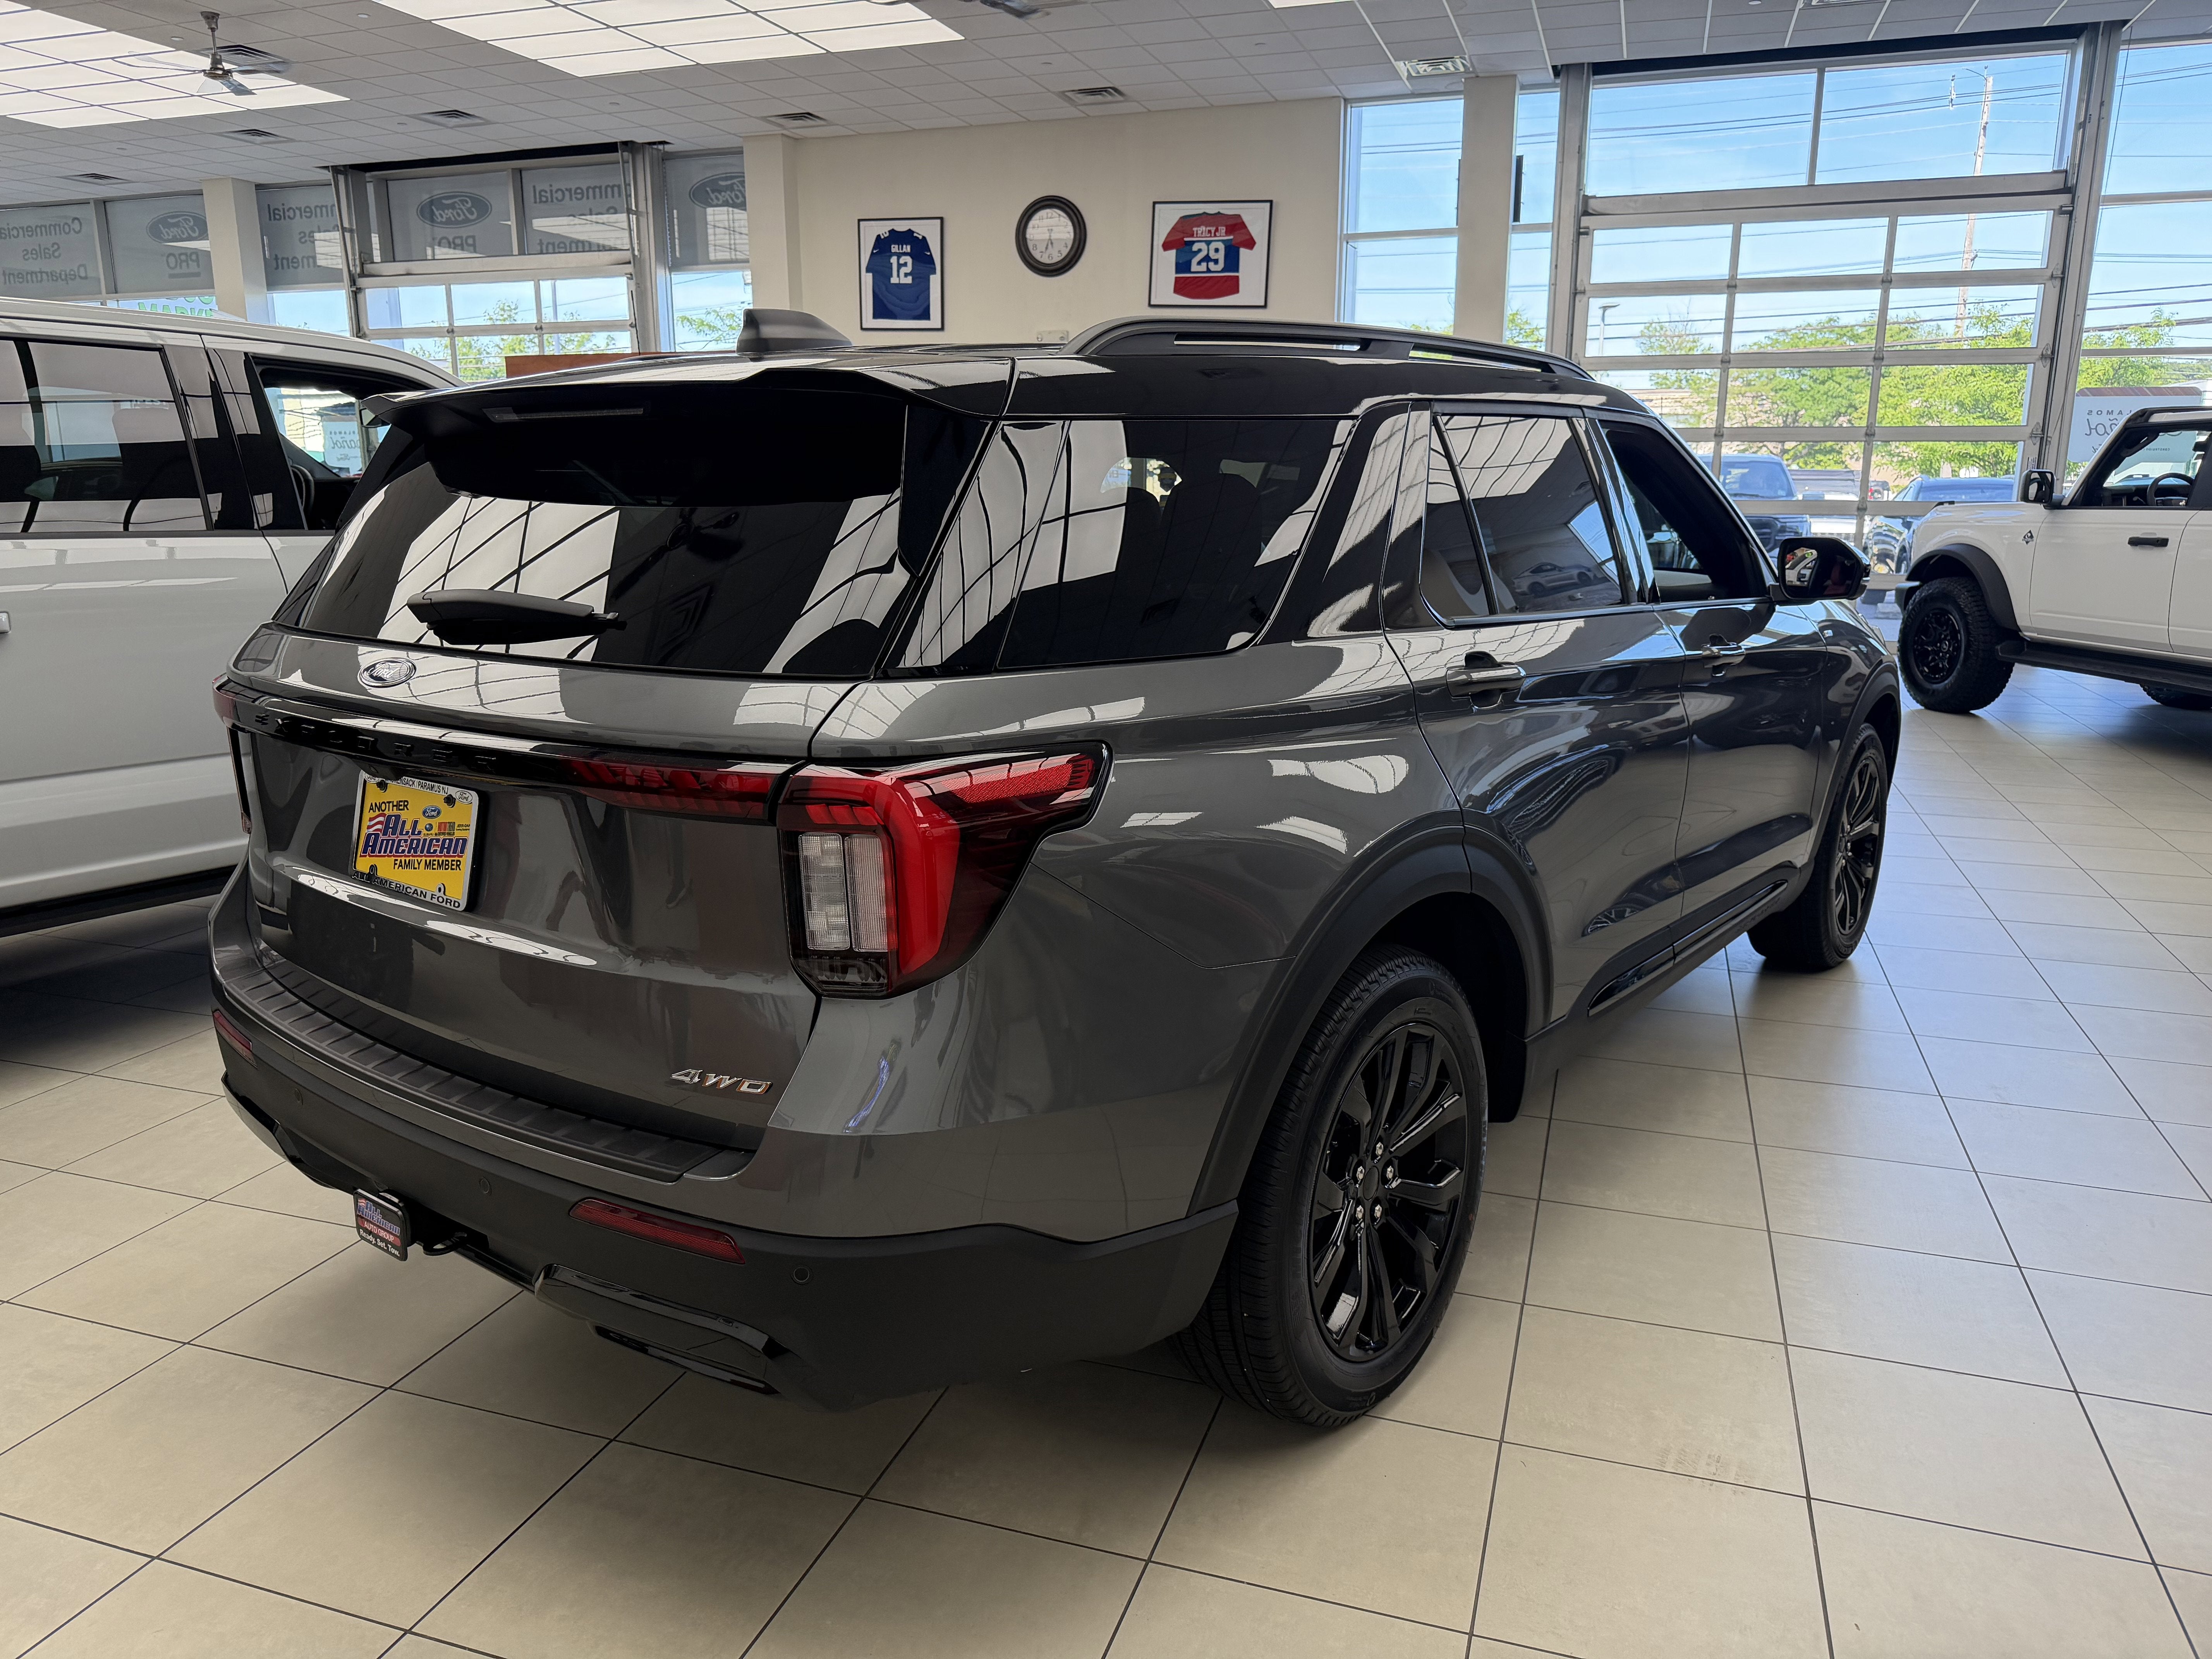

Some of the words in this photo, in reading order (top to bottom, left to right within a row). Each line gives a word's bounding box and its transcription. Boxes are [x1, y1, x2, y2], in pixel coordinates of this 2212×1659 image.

[1216, 227, 1226, 237] JR
[1190, 241, 1225, 272] 29
[890, 256, 913, 284] 12
[441, 787, 448, 795] NJ
[368, 800, 409, 813] ANOTHER
[393, 859, 422, 870] FAMILY
[424, 859, 462, 871] MEMBER
[352, 871, 370, 883] ALL
[373, 876, 426, 899] AMERICAN
[430, 894, 460, 908] FORD
[670, 1069, 773, 1094] 4WD
[359, 1229, 376, 1244] Ready.
[377, 1238, 387, 1250] Set.
[388, 1244, 400, 1257] Tow.
[364, 1221, 378, 1234] AUTO
[378, 1228, 394, 1242] GROUP
